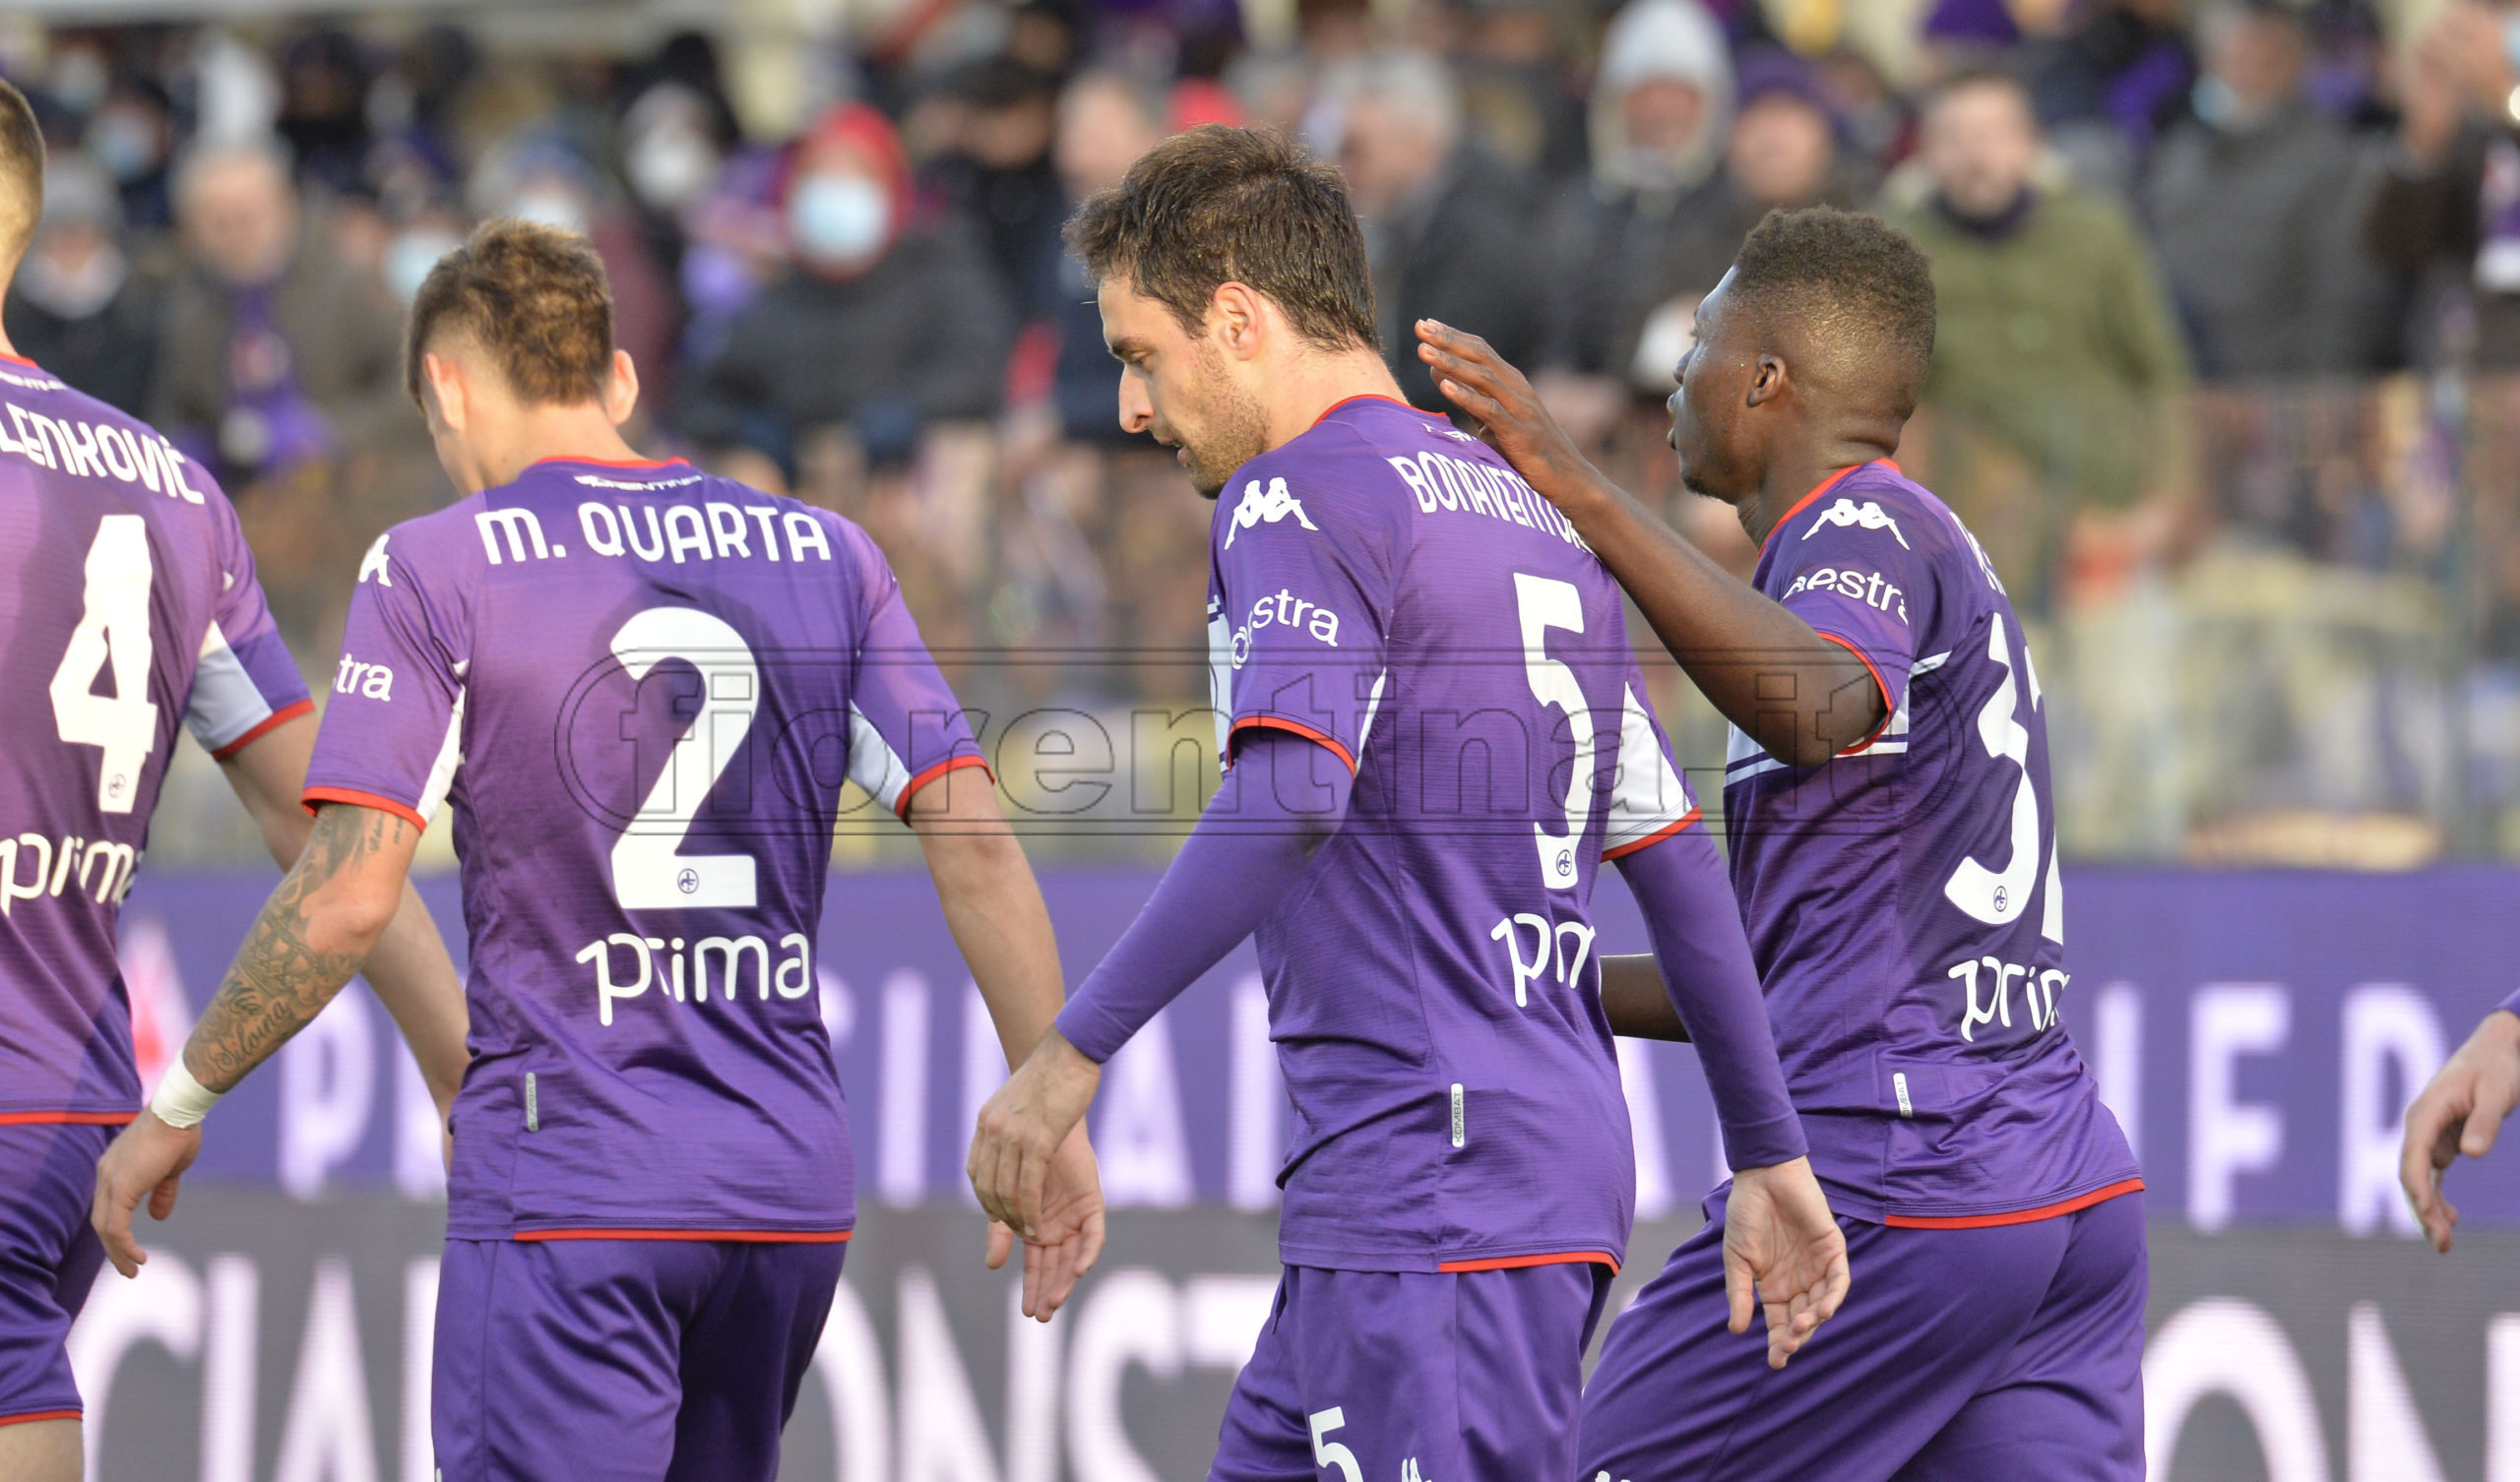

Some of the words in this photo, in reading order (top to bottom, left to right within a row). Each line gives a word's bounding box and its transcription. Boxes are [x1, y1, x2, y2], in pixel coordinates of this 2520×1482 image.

[0, 401, 205, 505] LENKOVIĆ
[579, 502, 832, 564] QUARTA
[49, 514, 158, 813] 4
[333, 652, 394, 702] tra
[609, 606, 759, 909] 2
[1513, 572, 1596, 891] 5
[576, 933, 810, 1026] prima
[1453, 1092, 1463, 1142] KOMBAT
[1308, 1405, 1364, 1482] 5
